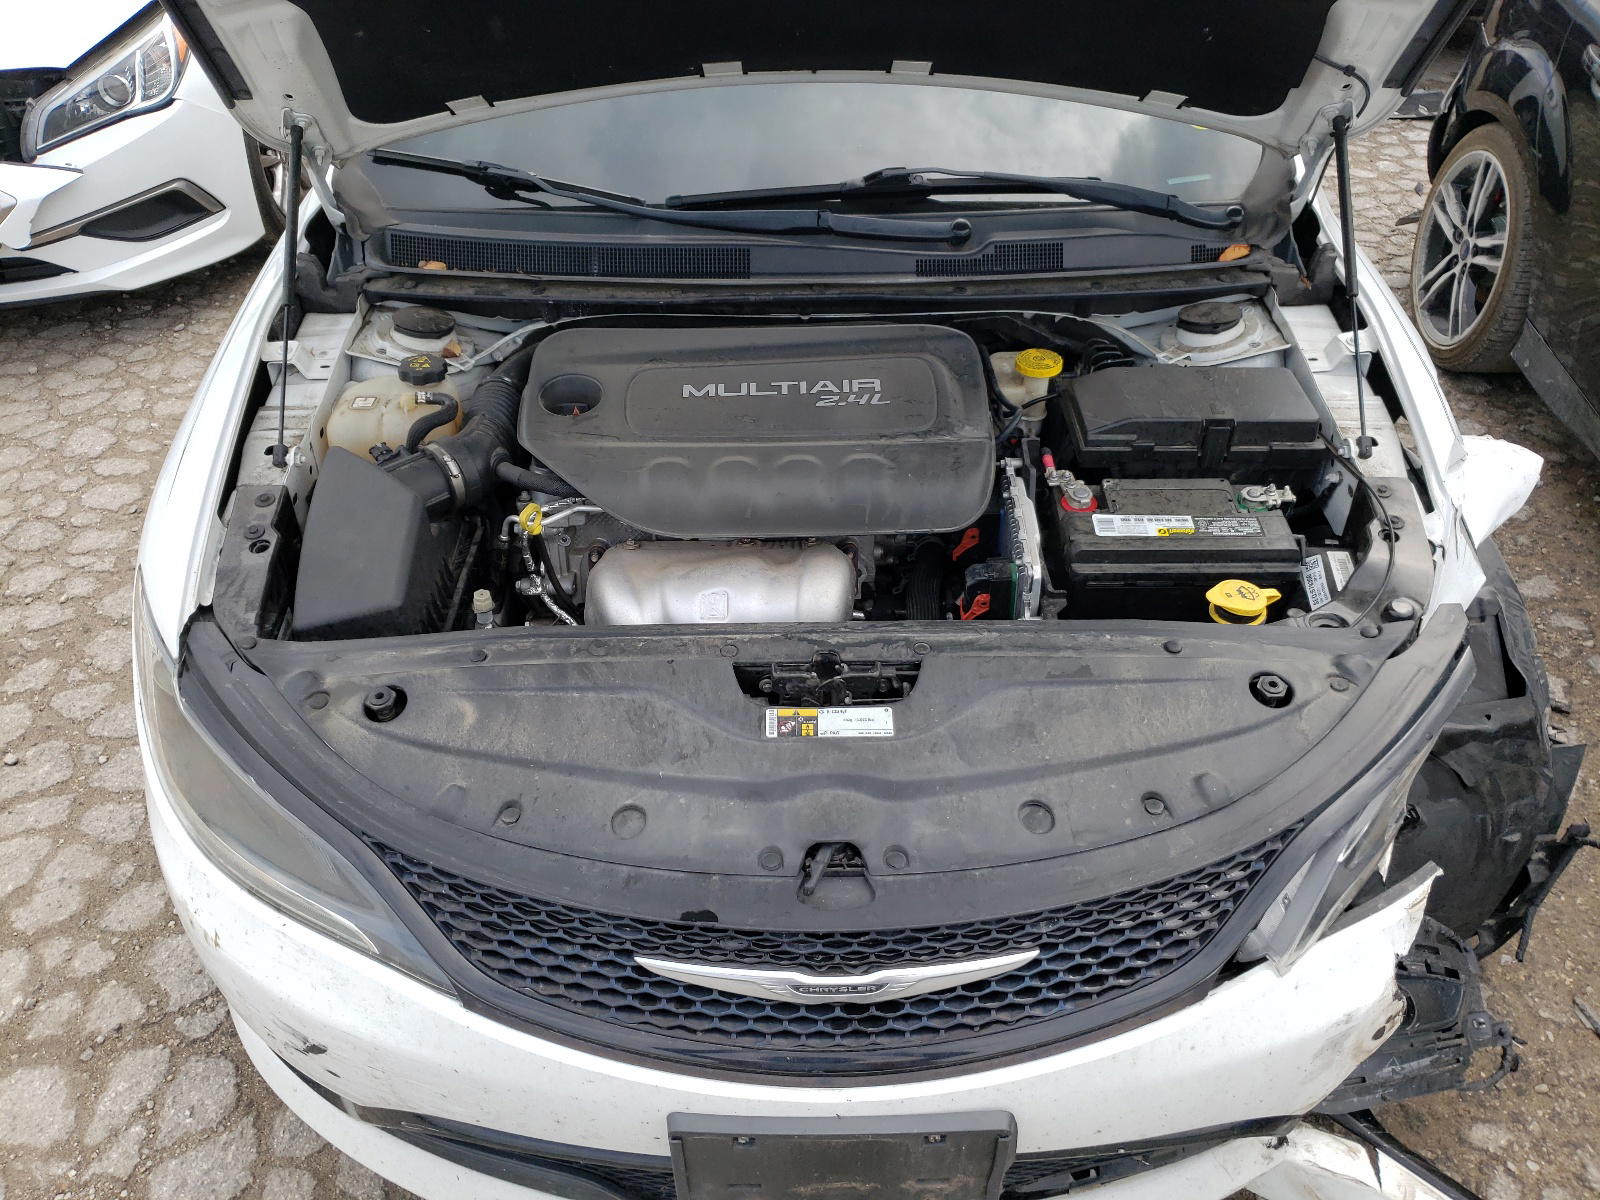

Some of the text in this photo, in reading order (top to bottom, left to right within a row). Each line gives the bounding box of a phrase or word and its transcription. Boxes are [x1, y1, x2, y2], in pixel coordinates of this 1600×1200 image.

[682, 378, 881, 398] MULTIAIR
[815, 393, 891, 407] 2.4L
[798, 985, 877, 993] CHRYSLER
